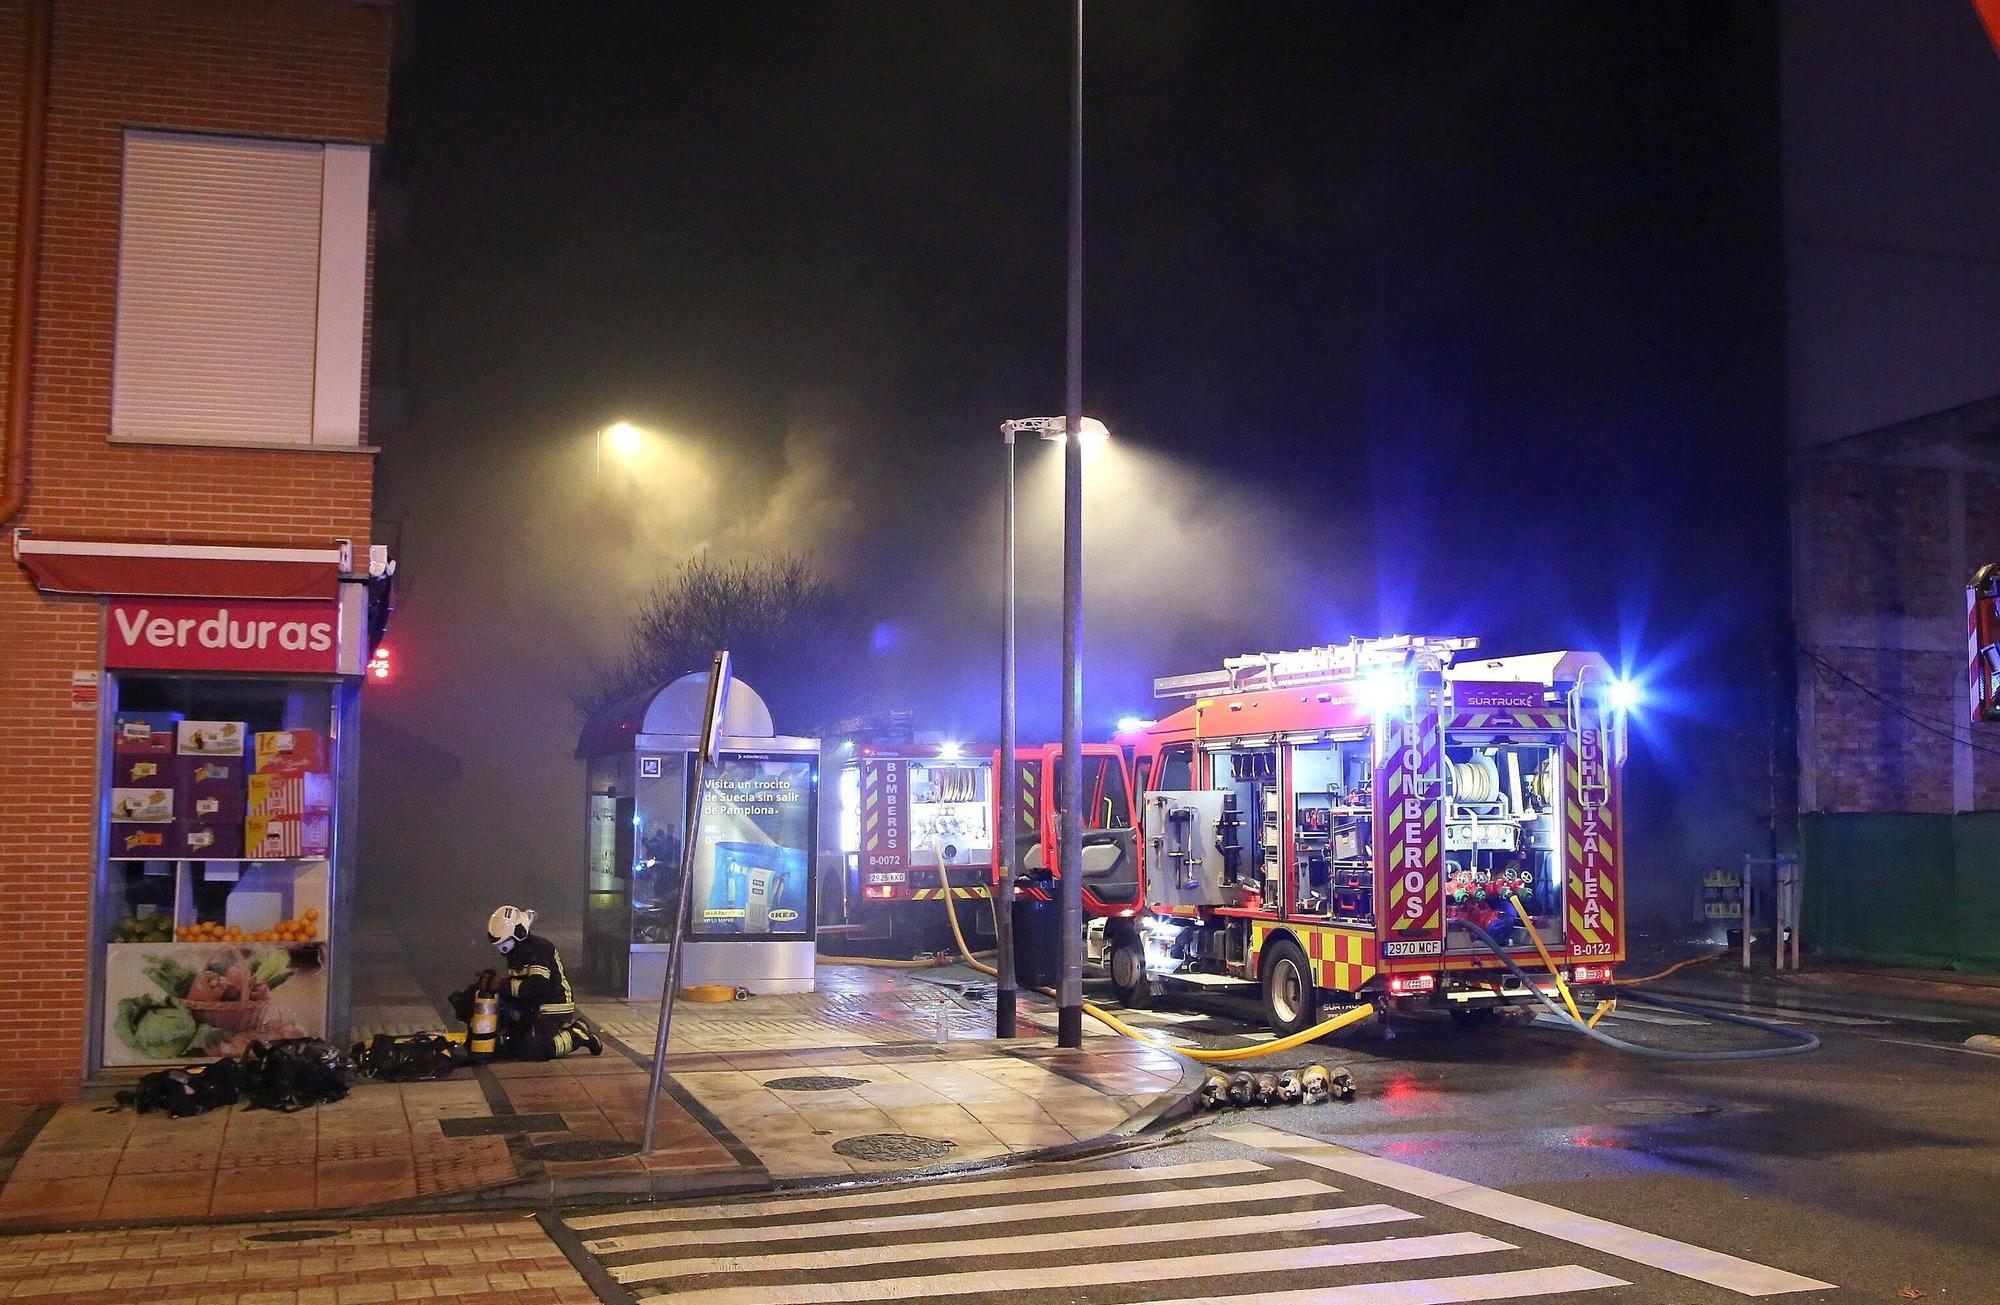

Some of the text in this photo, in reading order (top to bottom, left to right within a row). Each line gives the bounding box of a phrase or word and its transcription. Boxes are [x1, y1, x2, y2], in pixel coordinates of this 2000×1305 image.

[115, 608, 331, 651] Verduras
[1468, 697, 1527, 706] SURTRUCK
[704, 778, 790, 789] Visita un trocito
[704, 792, 800, 802] de Suecia sin salir
[704, 806, 779, 816] de Pamplona.
[886, 762, 898, 849] BOMBEROS
[1402, 724, 1424, 918] BOMBEROS
[869, 855, 900, 865] B-0072
[1389, 941, 1439, 955] 2970 MCF
[1574, 943, 1611, 956] B-0122
